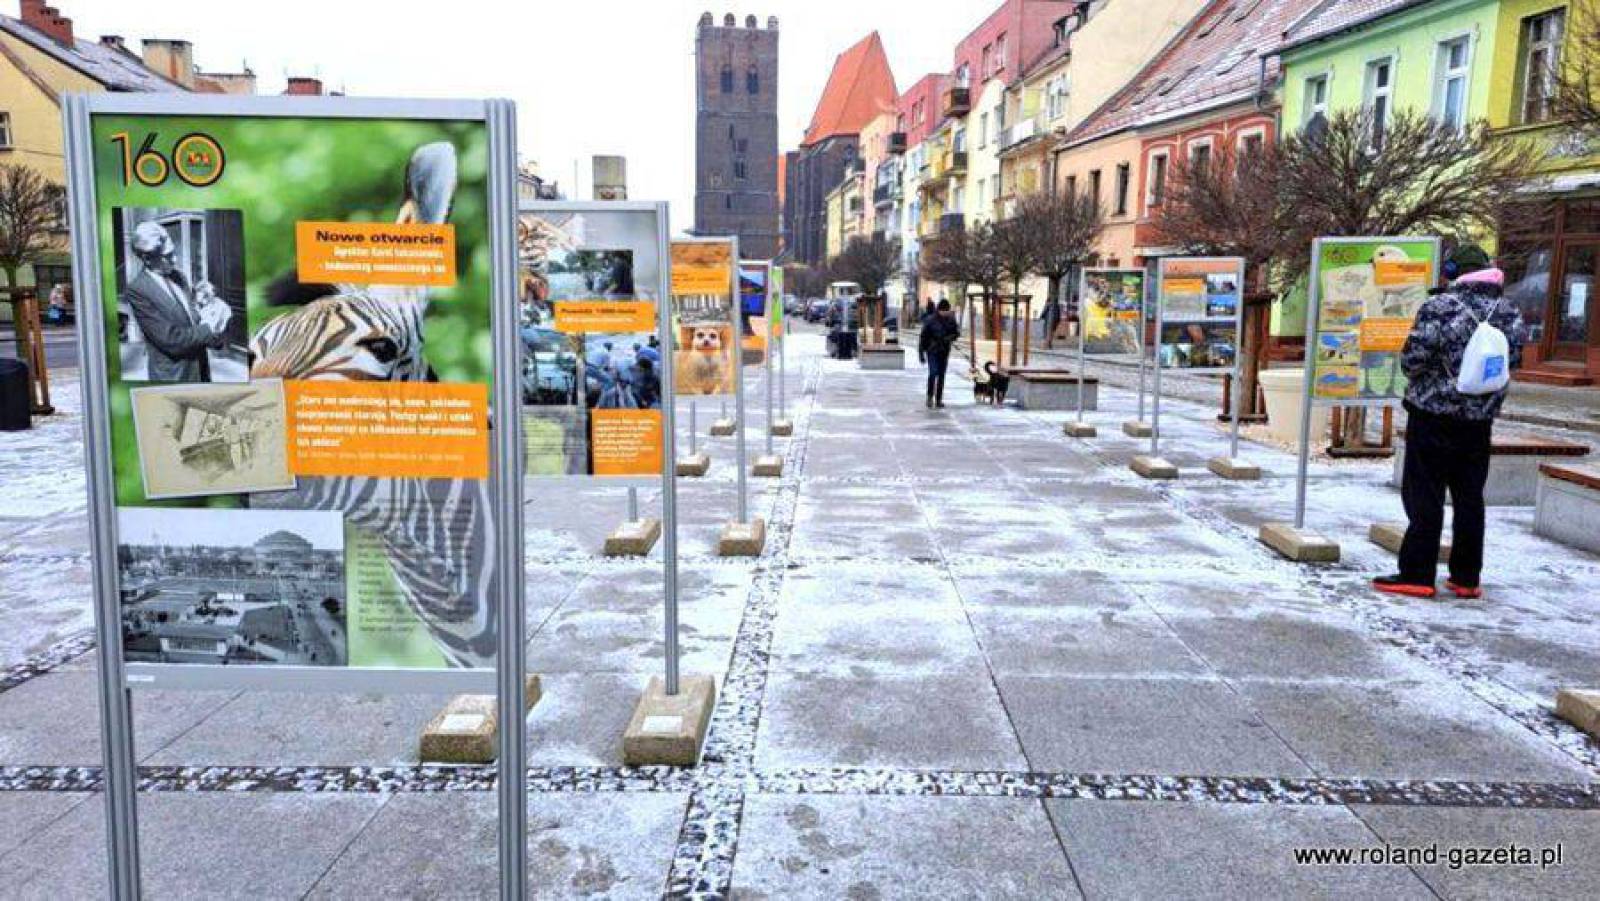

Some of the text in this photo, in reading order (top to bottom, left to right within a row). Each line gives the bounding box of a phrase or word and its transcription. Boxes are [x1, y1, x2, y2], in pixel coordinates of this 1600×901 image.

[111, 131, 225, 187] 160
[316, 230, 444, 244] Nowe otwarcie
